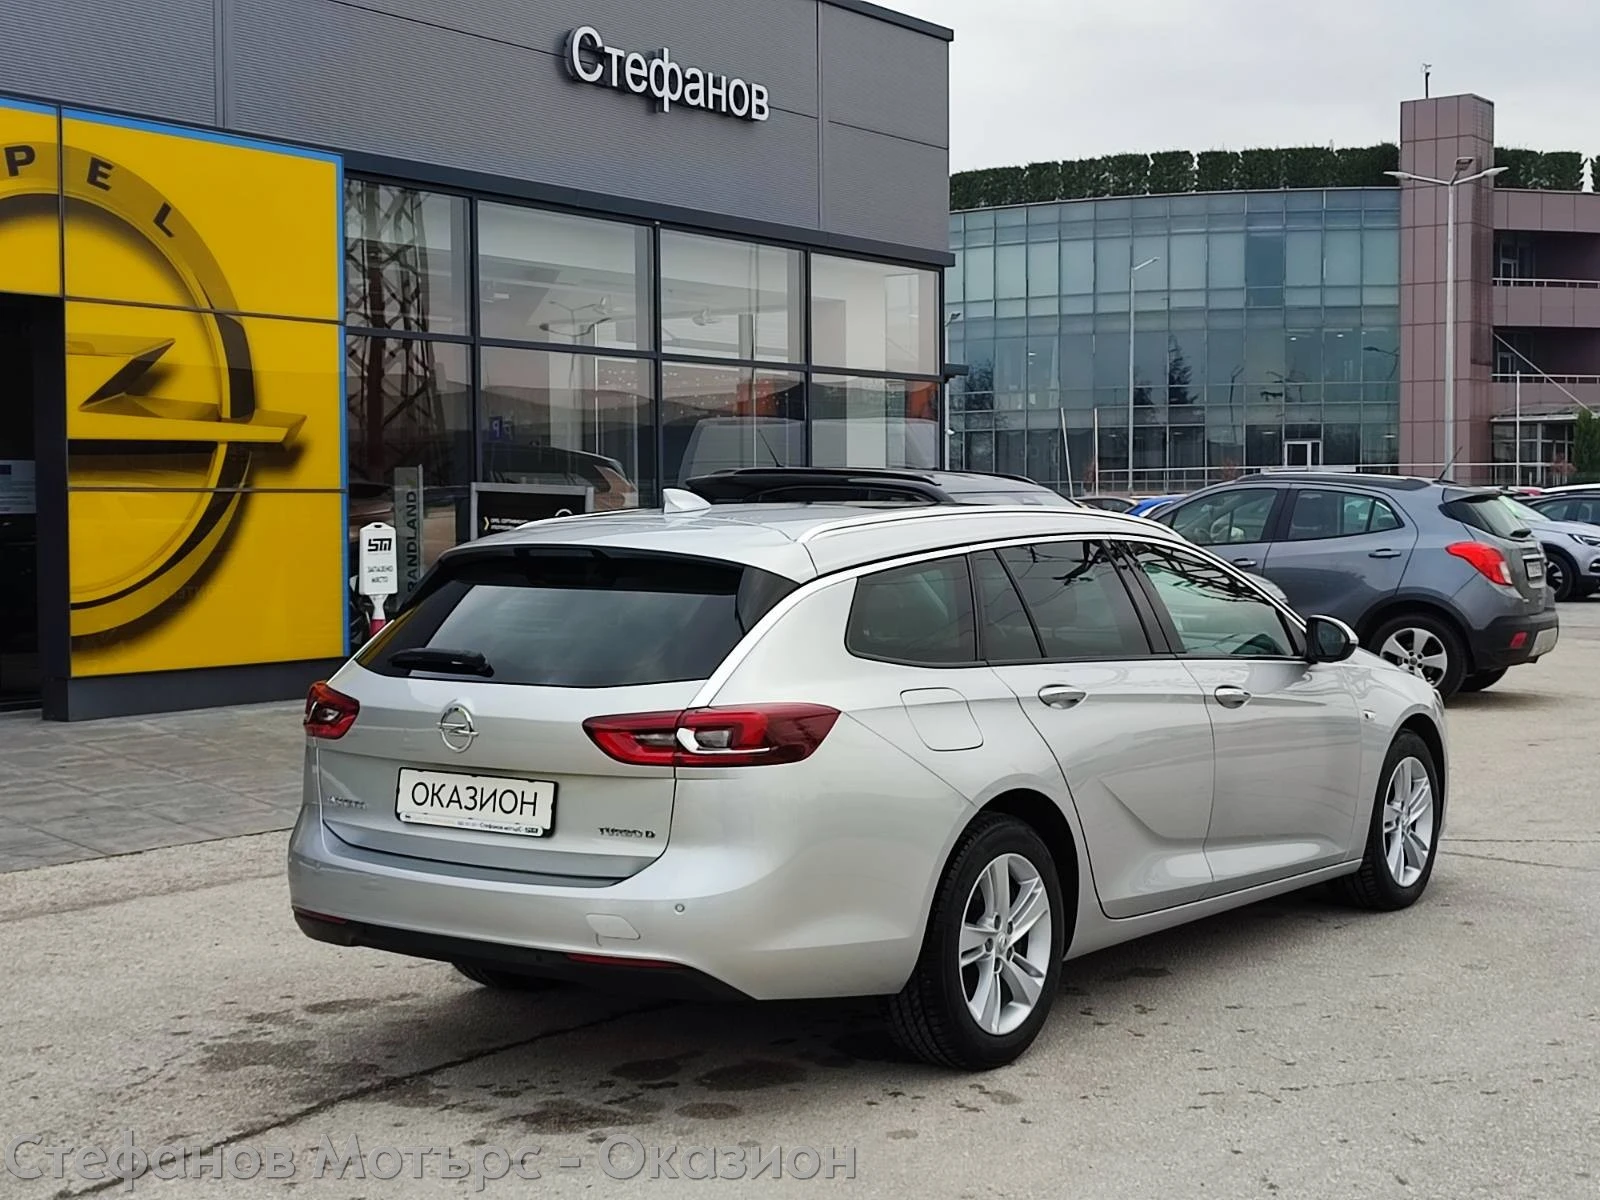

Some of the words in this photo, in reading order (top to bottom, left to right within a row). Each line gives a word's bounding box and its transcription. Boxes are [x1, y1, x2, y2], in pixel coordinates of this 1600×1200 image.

[571, 25, 770, 122] Стефанов
[3, 144, 175, 238] PEL
[406, 491, 419, 592] RANDLAND
[411, 781, 538, 817] ОКАЗИОН
